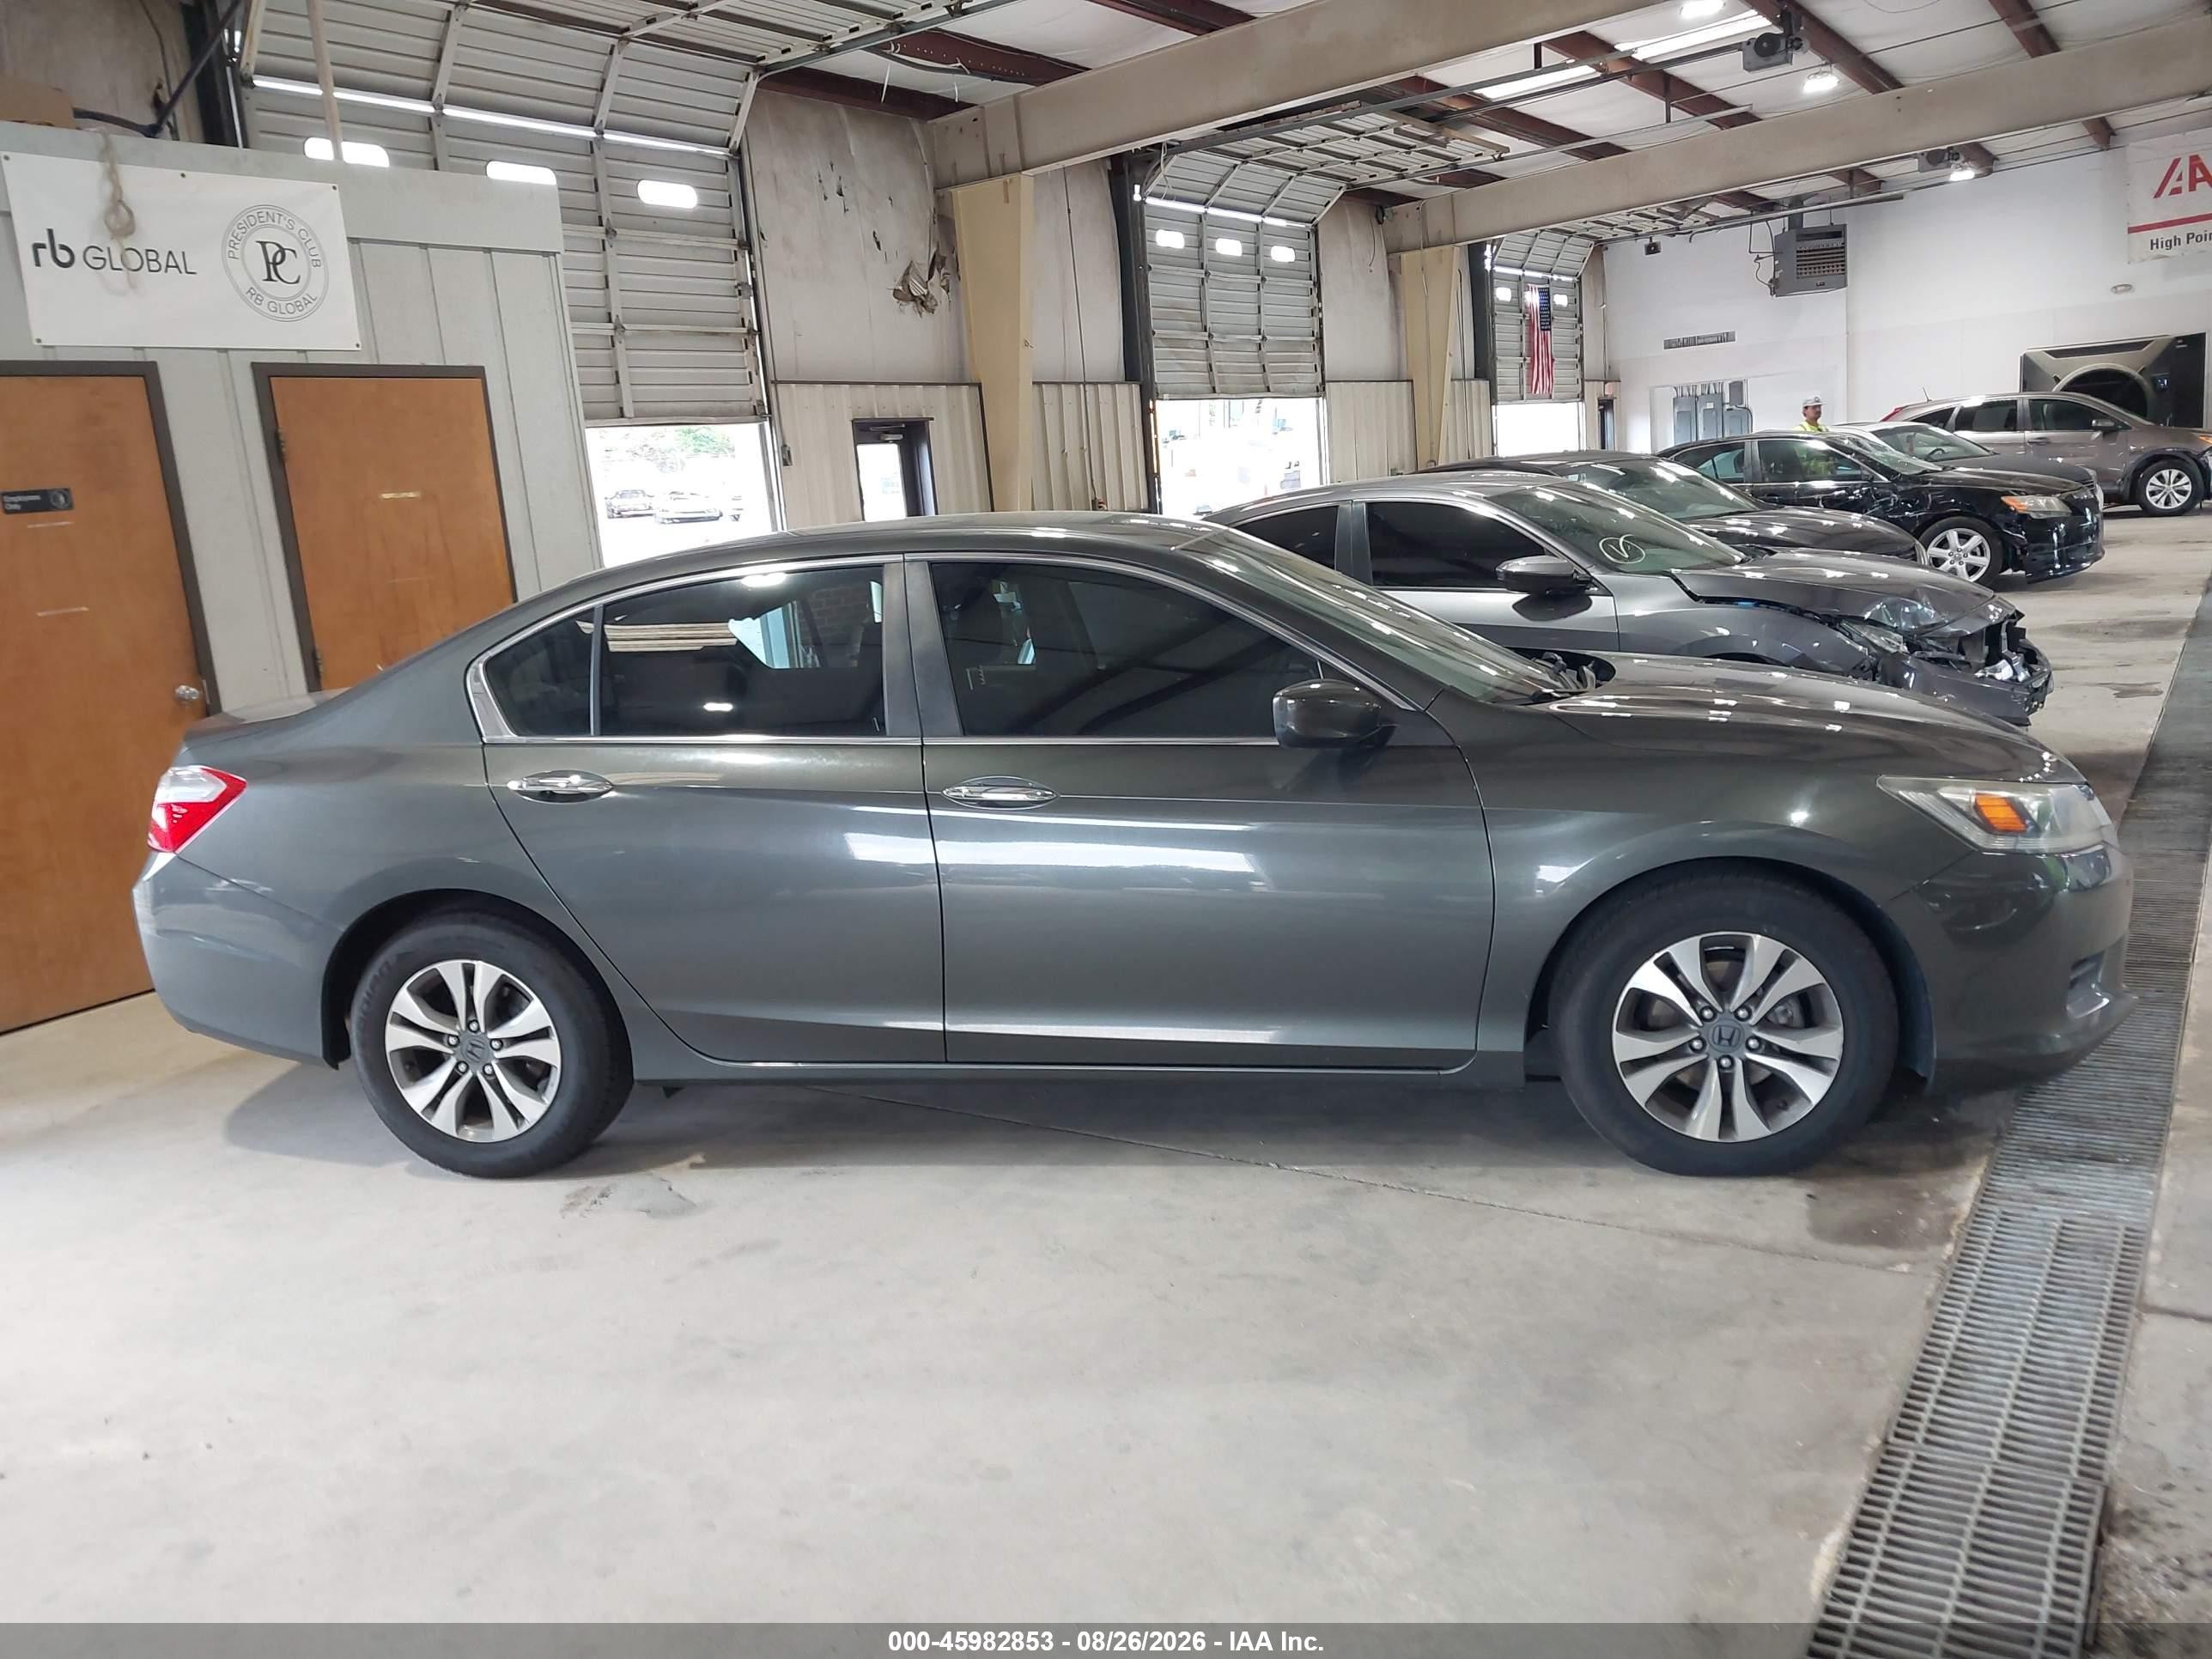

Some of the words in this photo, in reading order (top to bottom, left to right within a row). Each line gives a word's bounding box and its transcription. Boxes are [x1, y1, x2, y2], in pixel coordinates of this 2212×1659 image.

[32, 228, 76, 269] rb
[82, 245, 198, 276] GLOBAL
[227, 210, 295, 260] PRESIDENT'S
[297, 228, 322, 268] CLUB
[2150, 235, 2181, 251] High
[255, 240, 301, 285] PC
[246, 287, 264, 307] RB
[267, 293, 318, 315] GLOBAL
